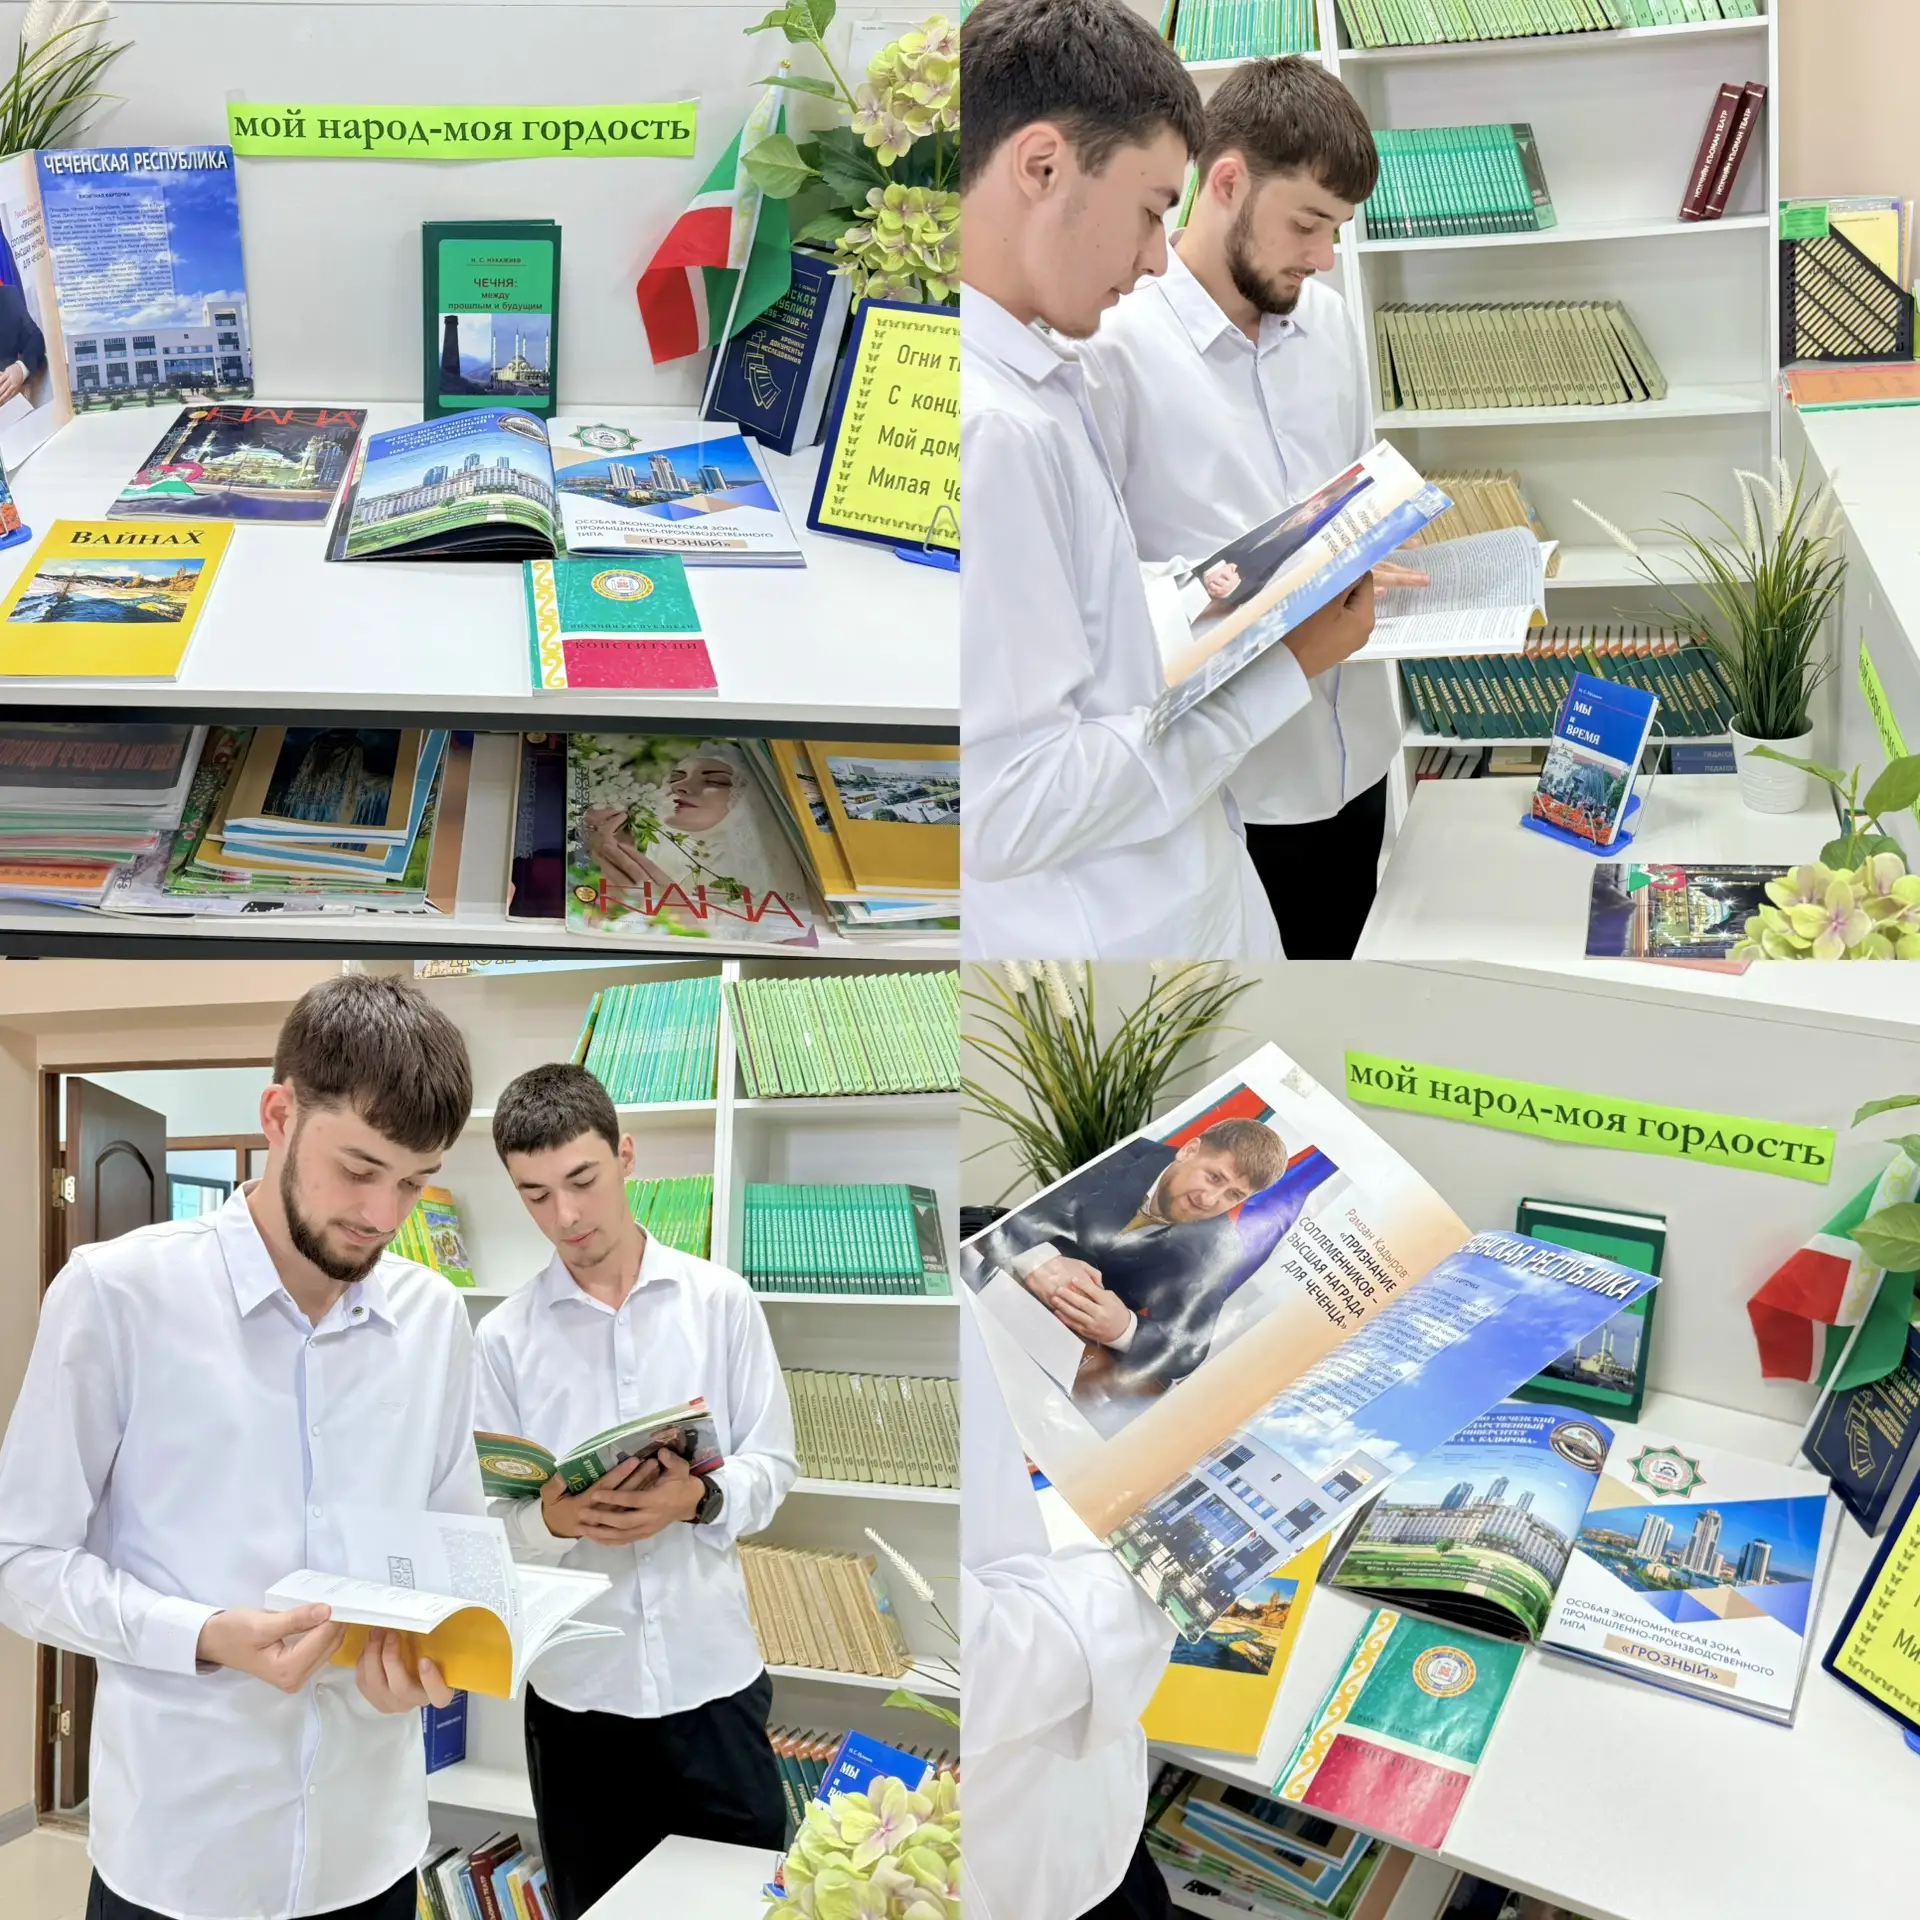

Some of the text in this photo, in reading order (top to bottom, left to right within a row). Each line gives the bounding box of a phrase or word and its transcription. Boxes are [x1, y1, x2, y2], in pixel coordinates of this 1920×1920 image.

[234, 107, 690, 150] мой народ-моя гордость
[1716, 110, 1728, 132] ТЕАТР
[1739, 108, 1752, 130] ТЕАТР
[44, 151, 229, 174] ЧЕЧЕНСКАЯ РЕСПУБЛИКА
[474, 278, 518, 288] ЧЕЧНЯ:
[482, 292, 510, 300] между
[502, 302, 542, 310] будущим
[786, 290, 817, 306] СКАЯ
[776, 300, 814, 320] УБЛИКА
[897, 344, 942, 369] Огни
[888, 384, 901, 405] С
[878, 425, 917, 450] Мой
[868, 466, 930, 496] Милая
[575, 525, 774, 538] ПРОМЫШЛЕННО-ПРОИЗВОДСТВЕННОГО
[619, 520, 709, 532] ЭКОНОМИЧЕСКАЯ
[641, 536, 731, 548] «ГРОЗНЫЙ»
[1573, 700, 1592, 716] МЫ
[1566, 724, 1600, 745] ВРЕМЯ
[1350, 1063, 1826, 1168] мой народ-моя гордость
[1345, 1208, 1410, 1280] Рамзан Кадыров:
[1298, 1216, 1375, 1298] СОПЛЕМЕННИКОВ
[1340, 1232, 1397, 1293] «ПРИЗНАНИЕ
[1287, 1232, 1365, 1318] ВЫСШАЯ НАГРАДА
[1524, 1250, 1641, 1301] РЕСПУБЛИКА
[1280, 1260, 1347, 1330] ДЛЯ ЧЕЧЕНЦА»
[808, 1455, 816, 1463] 10
[820, 1455, 828, 1464] 10
[845, 1456, 854, 1466] 10
[856, 1458, 865, 1466] 10
[882, 1460, 891, 1470] 10
[908, 1462, 916, 1471] 10
[934, 1464, 943, 1472] 10
[948, 1465, 956, 1474] 10
[1560, 1618, 1586, 1632] ТИПА
[1566, 1598, 1742, 1656] ОСОБАЯ ЭКОНОМИЧЕСКАЯ ЗОНА
[1562, 1607, 1774, 1677] ПРОМЫШЛЕННО-ПРОИЗВОДСТВЕННОГО
[1621, 1644, 1719, 1682] «ГРОЗНЫЙ»
[840, 1762, 860, 1780] МЫ
